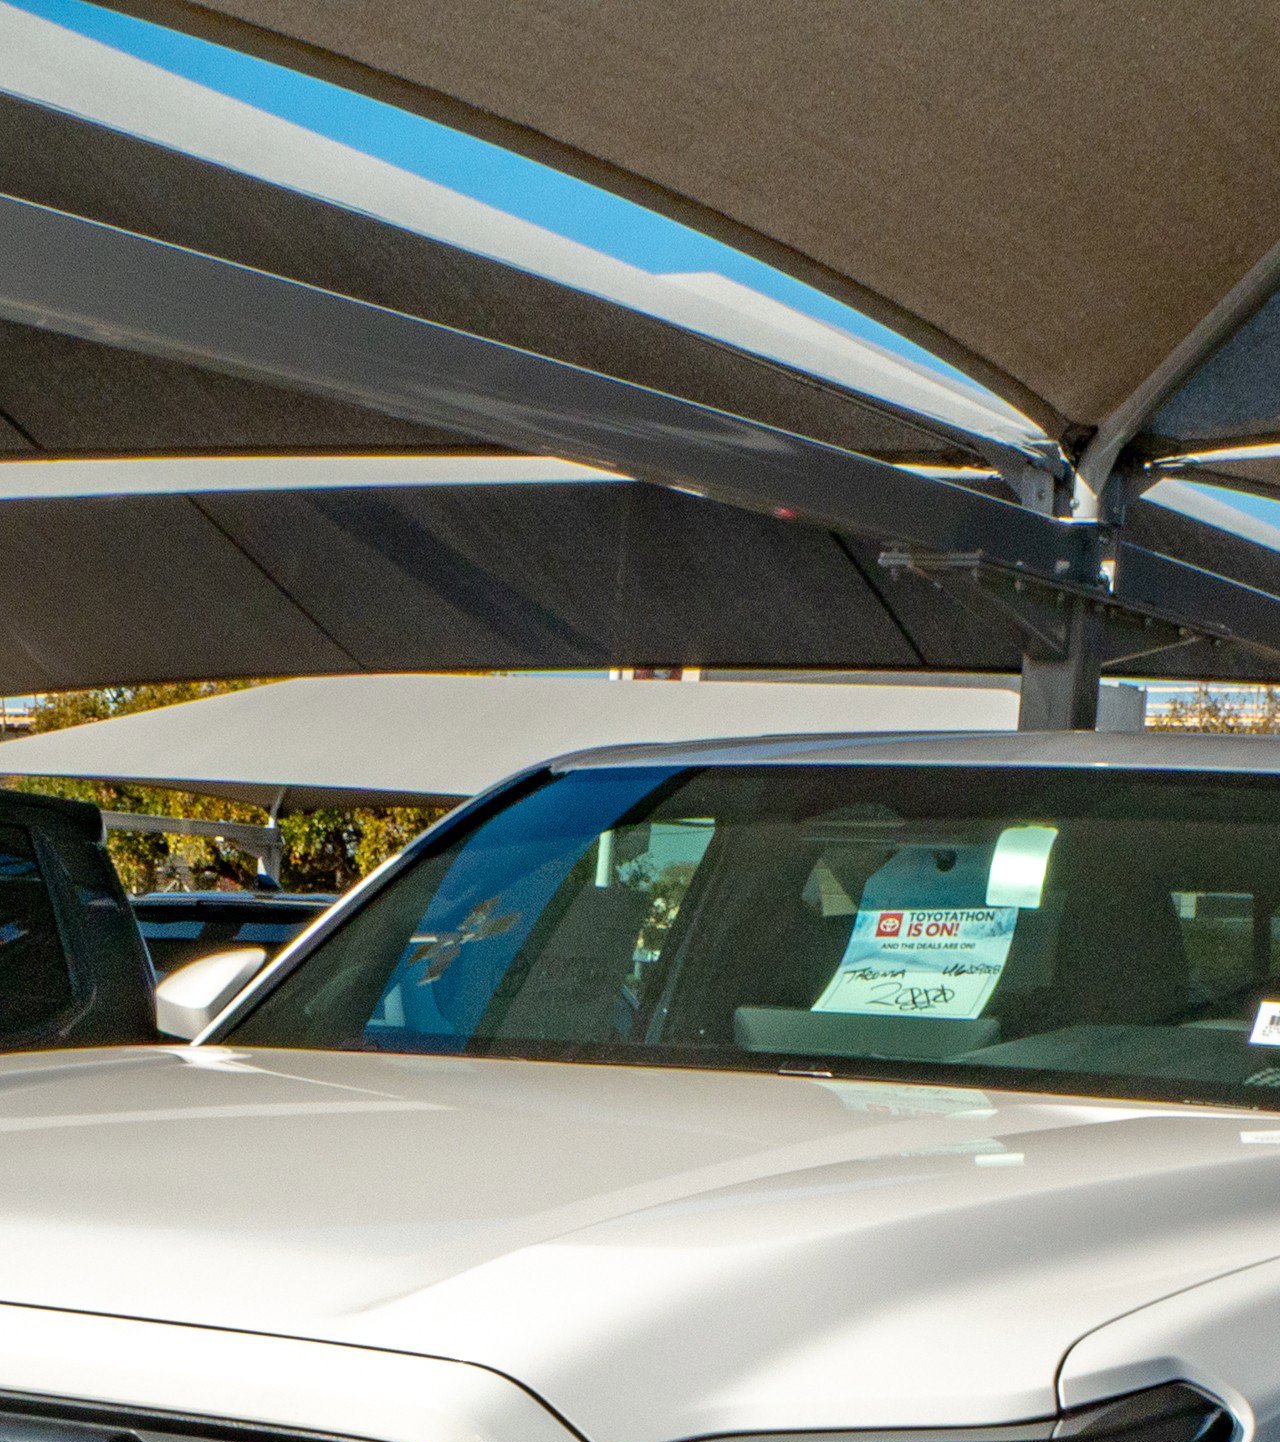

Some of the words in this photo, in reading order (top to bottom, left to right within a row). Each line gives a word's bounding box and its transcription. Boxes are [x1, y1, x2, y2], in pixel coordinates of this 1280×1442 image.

[910, 911, 995, 922] TOYOTATHON
[907, 922, 923, 937] IS
[926, 922, 959, 937] ON!
